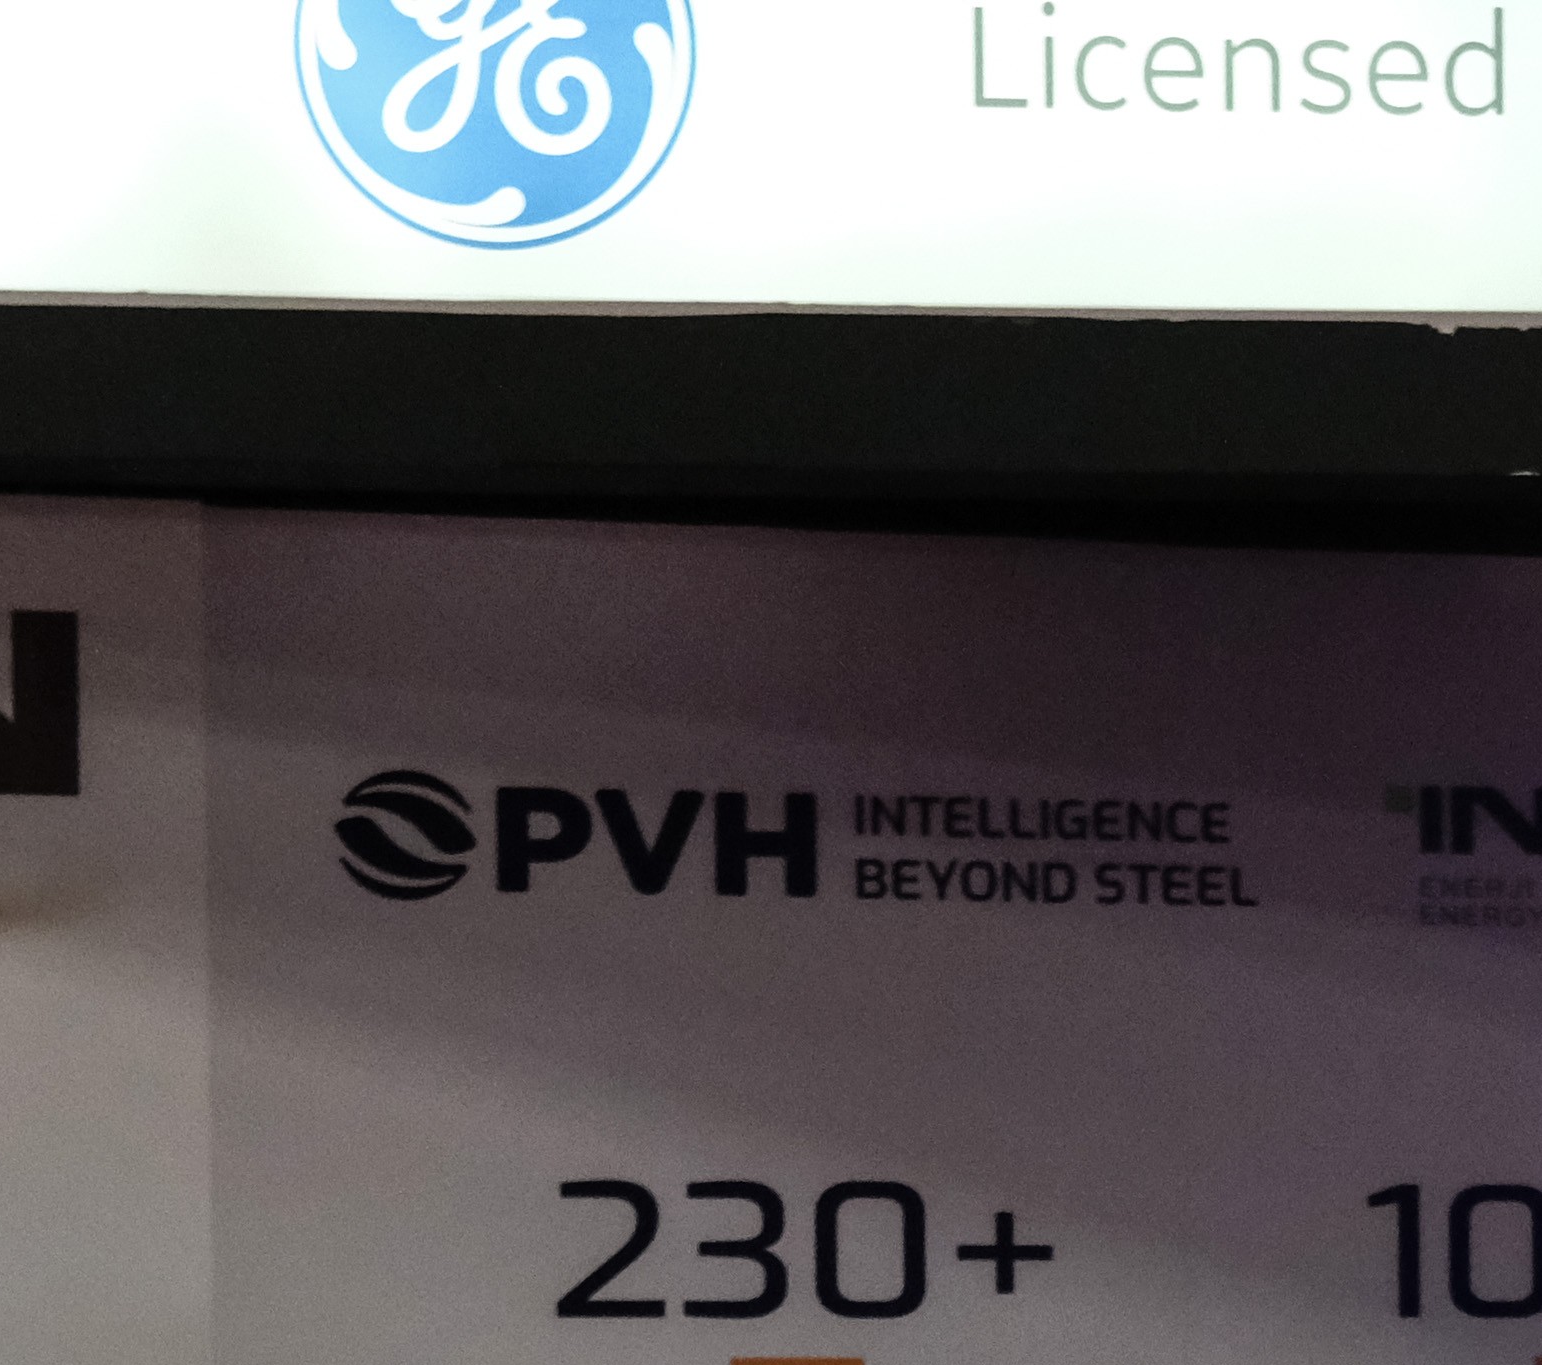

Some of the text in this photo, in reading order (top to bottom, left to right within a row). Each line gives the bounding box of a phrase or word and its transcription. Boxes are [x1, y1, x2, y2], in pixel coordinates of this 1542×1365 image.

[973, 2, 1505, 117] Licensed
[496, 787, 819, 898] PVH
[855, 794, 1232, 845] INTELLIGENCE
[856, 858, 1257, 908] BEYOND STEEL
[556, 1178, 1056, 1320] 230+
